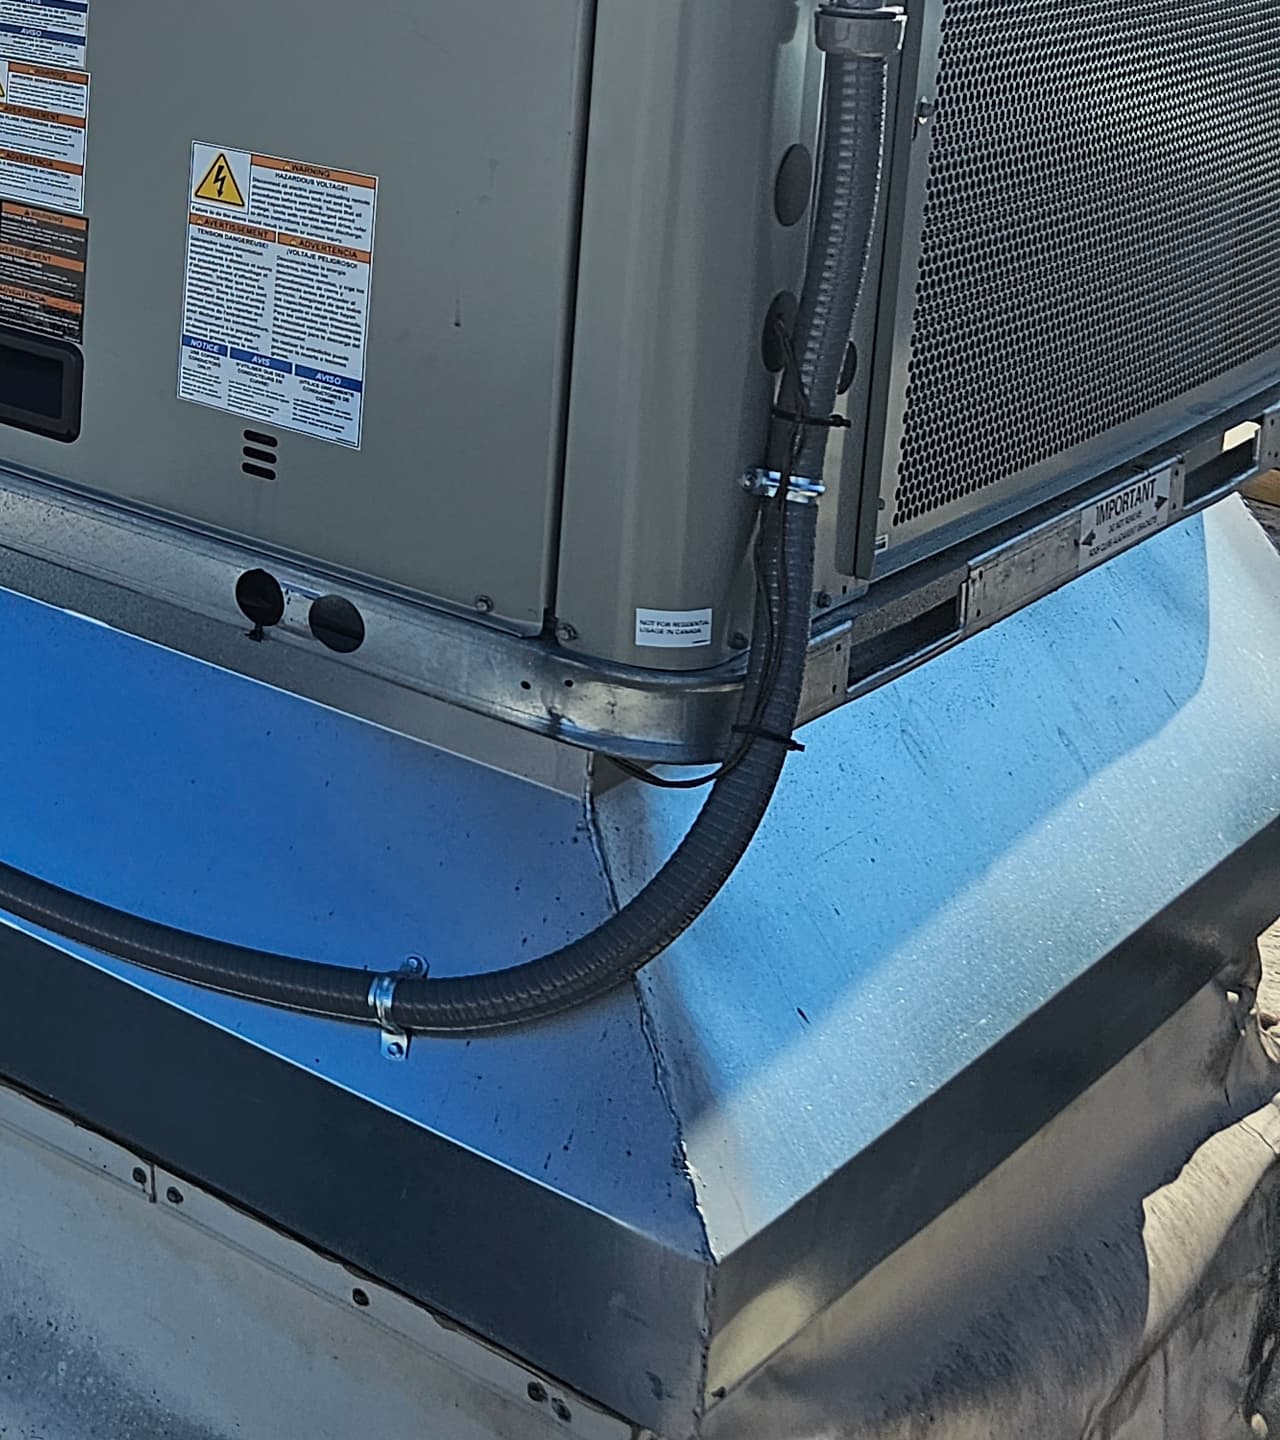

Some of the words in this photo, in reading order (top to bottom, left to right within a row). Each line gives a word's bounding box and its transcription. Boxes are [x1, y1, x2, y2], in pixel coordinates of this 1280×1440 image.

[275, 173, 314, 185] HAZARDOUS
[316, 180, 348, 192] VOLTAGE!
[292, 165, 330, 178] WARNING
[203, 219, 268, 237] AVERTISSEMENT
[299, 241, 357, 258] ADVERTENCIA
[191, 340, 219, 352] NOTICE
[251, 356, 270, 366] AVIS
[315, 372, 341, 385] AVISO
[1096, 478, 1157, 526] IMPORTANT
